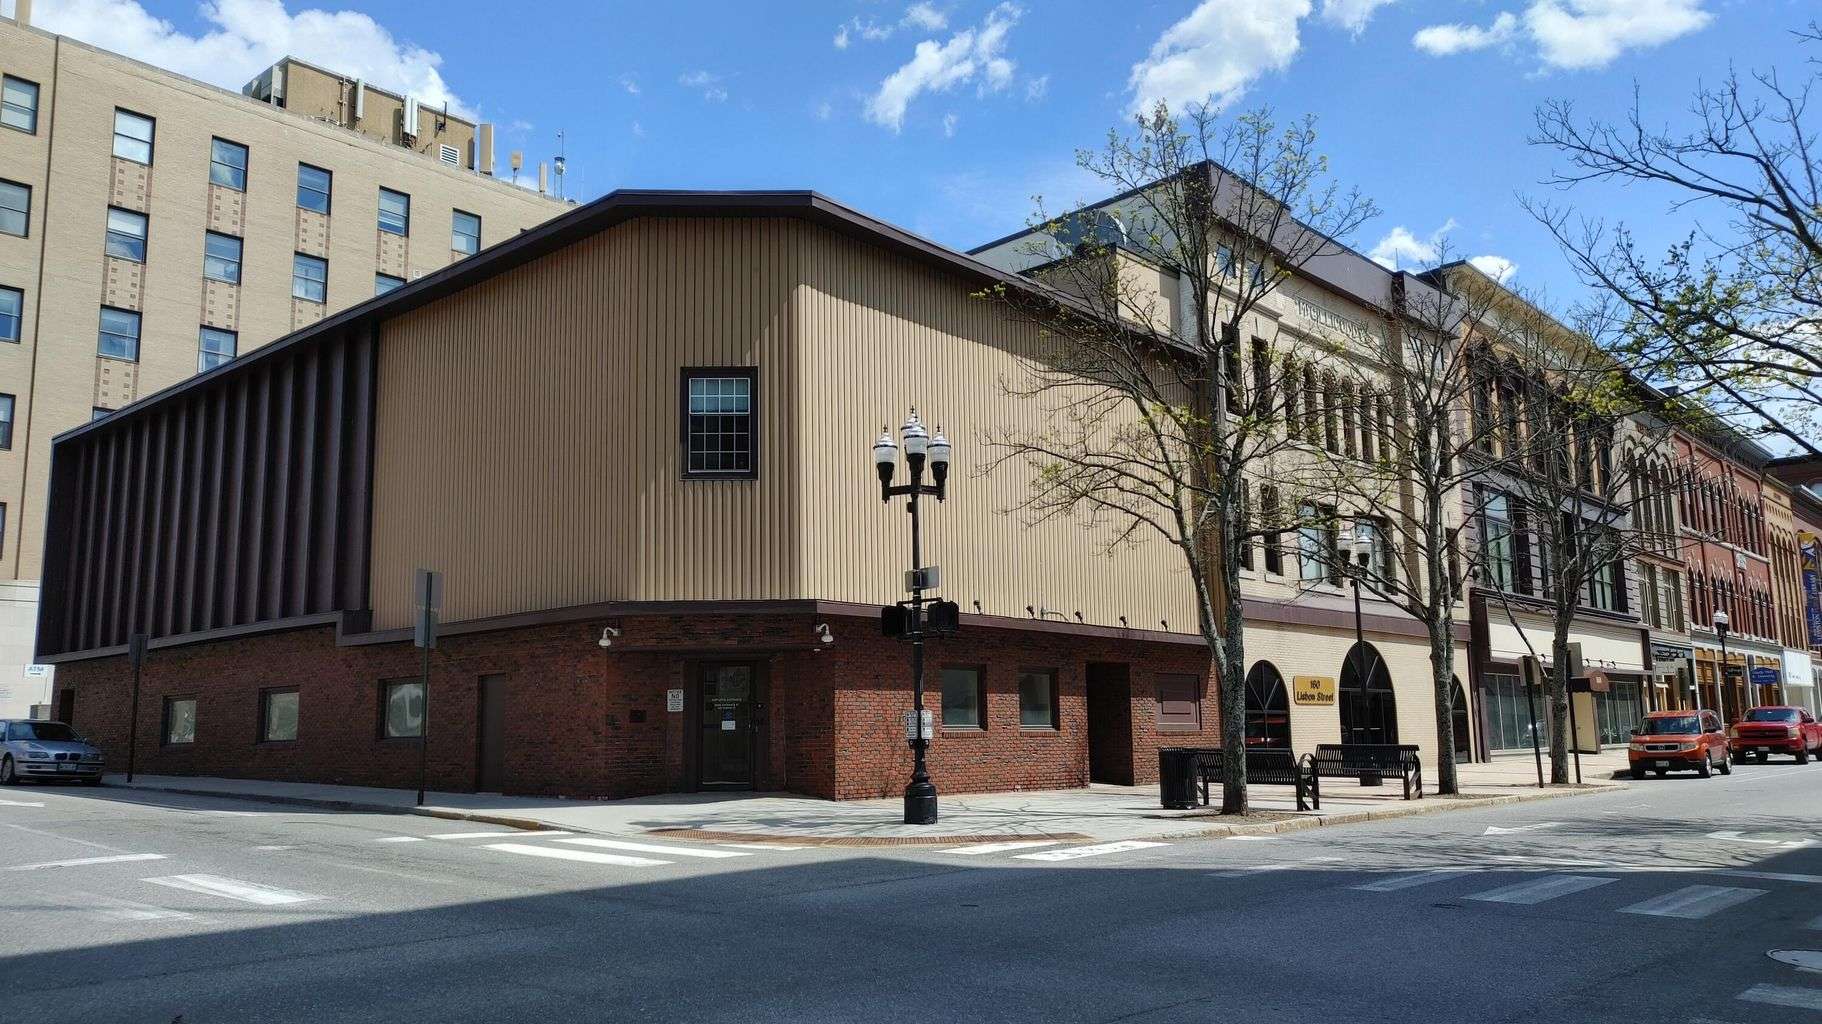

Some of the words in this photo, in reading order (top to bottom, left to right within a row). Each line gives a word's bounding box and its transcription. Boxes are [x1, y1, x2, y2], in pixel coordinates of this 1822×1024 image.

[1310, 680, 1321, 689] 160
[1296, 691, 1315, 701] Lisbon
[1316, 692, 1334, 702] Street
